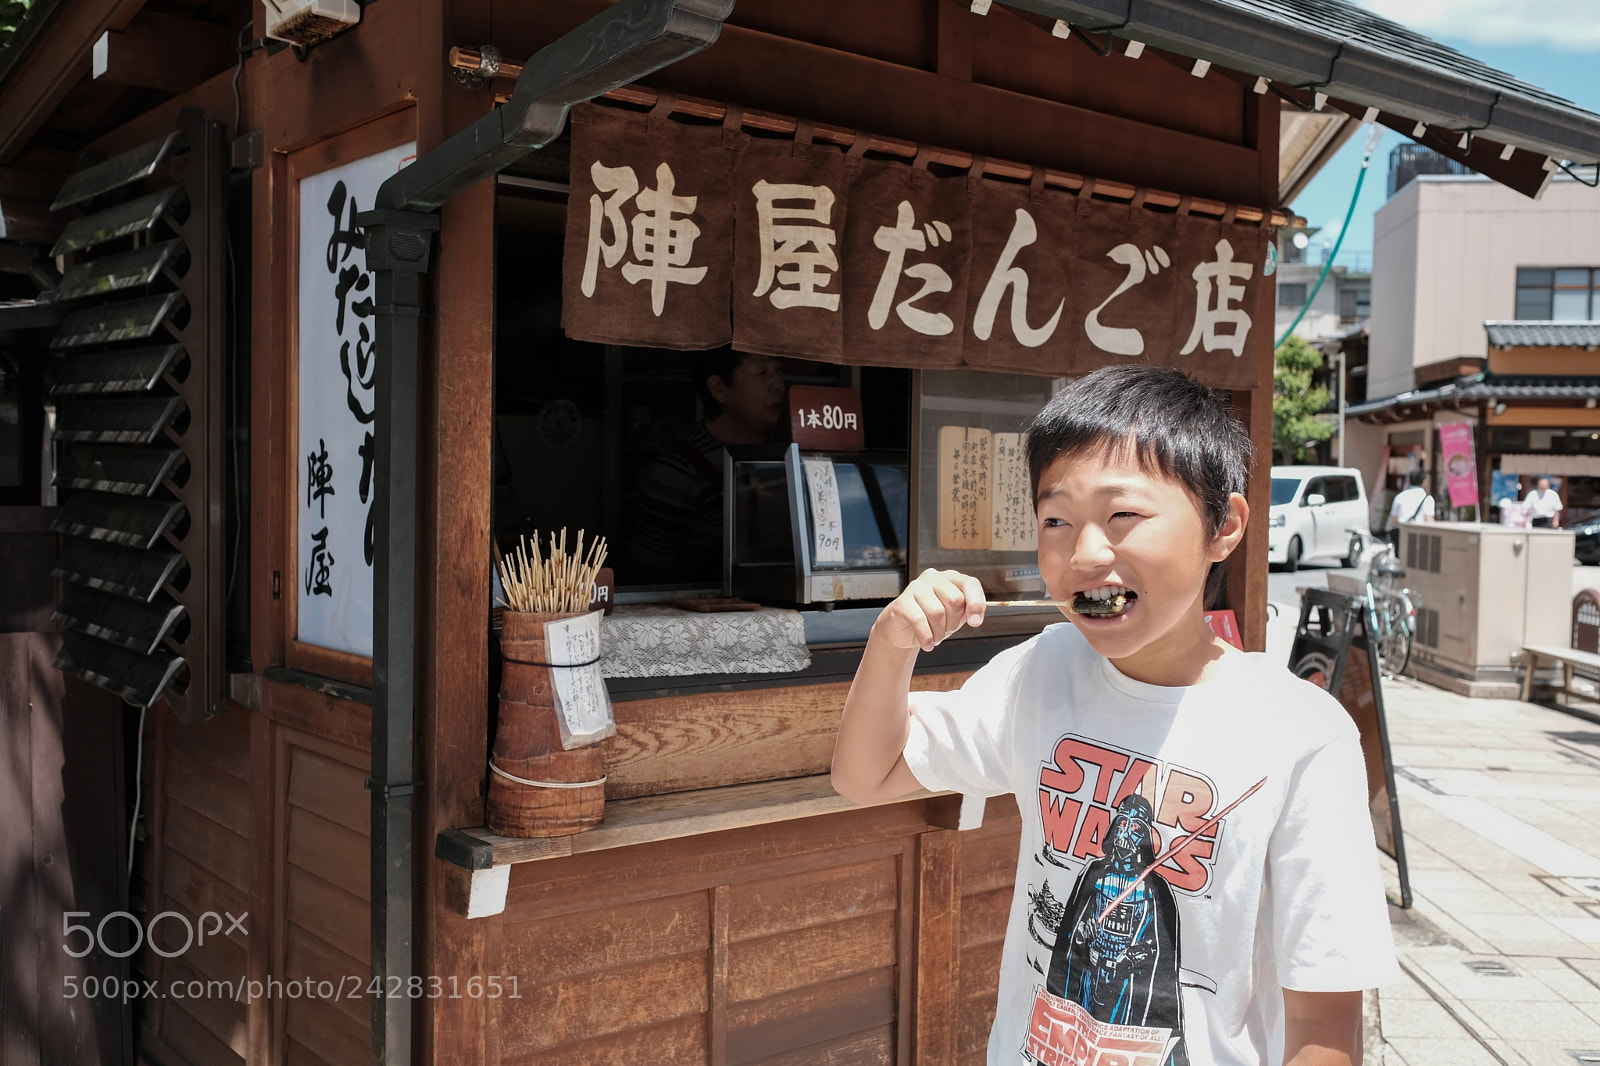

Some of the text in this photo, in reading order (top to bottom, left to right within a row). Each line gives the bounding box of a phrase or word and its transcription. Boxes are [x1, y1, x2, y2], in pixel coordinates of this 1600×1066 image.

[580, 159, 1254, 358] 陣屋だんご店
[798, 404, 858, 431] 1本80円
[305, 438, 336, 598] 陣屋
[1040, 737, 1220, 839] STAR
[1038, 788, 1214, 893] WAS
[1109, 1025, 1150, 1035] ADAPTATION
